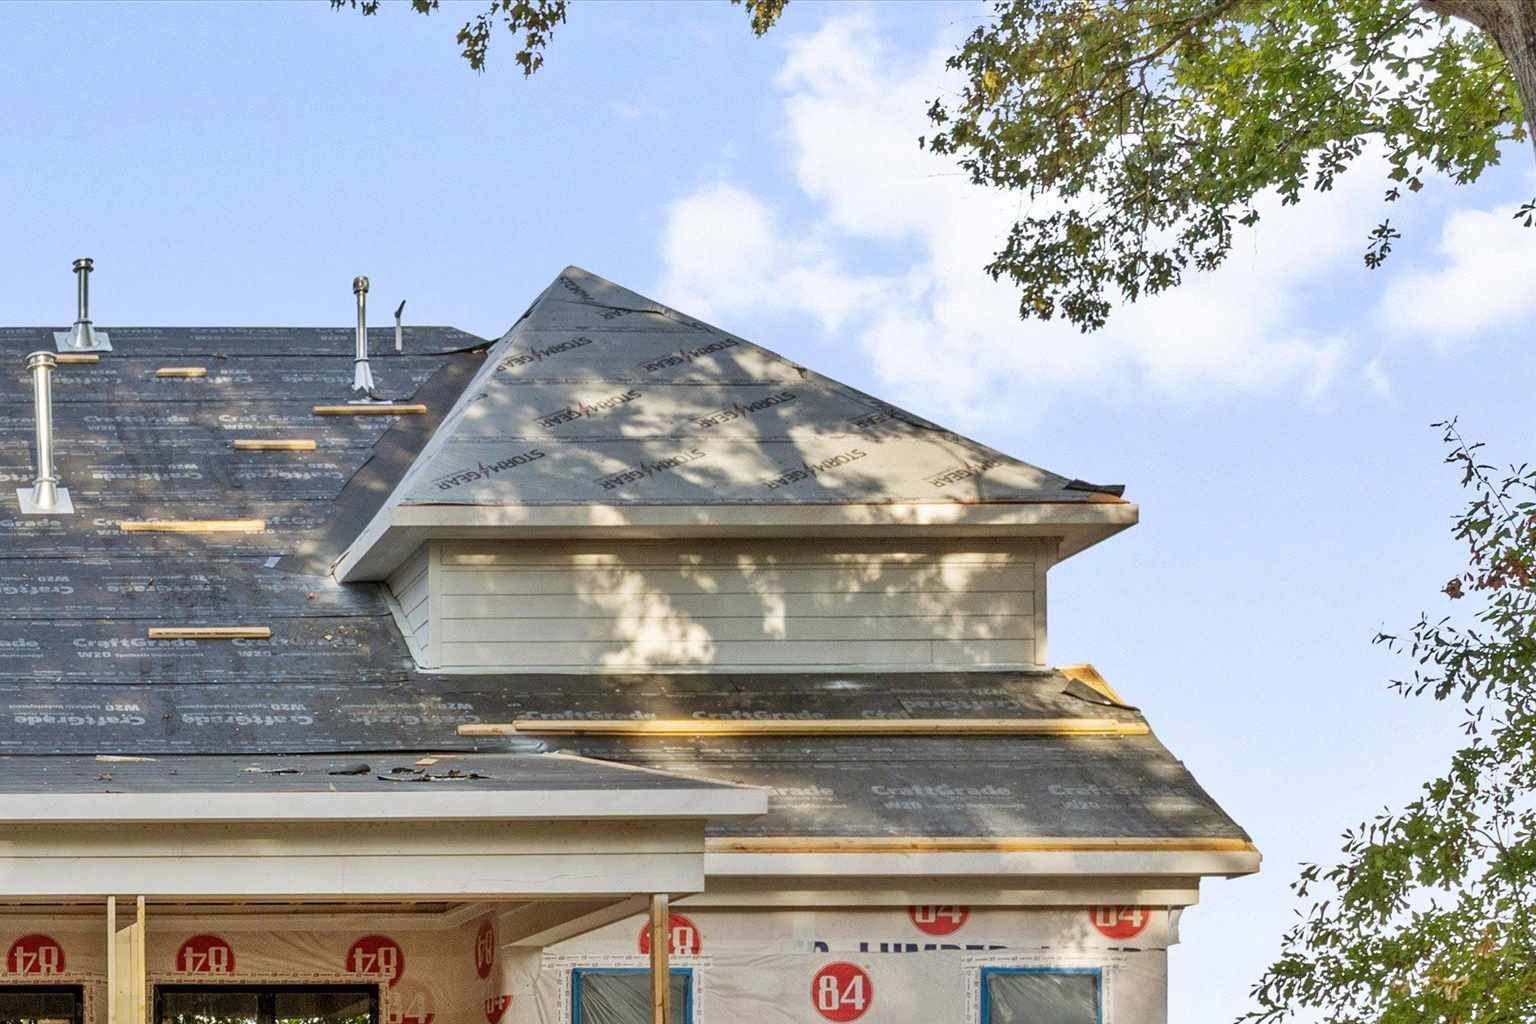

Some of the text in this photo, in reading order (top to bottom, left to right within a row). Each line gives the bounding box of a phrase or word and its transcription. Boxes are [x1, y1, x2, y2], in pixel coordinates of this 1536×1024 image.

[434, 447, 546, 491] STORM GEAR
[13, 713, 146, 726] CraftGrade
[104, 702, 141, 712] W20
[182, 713, 314, 726] CraftGrade
[270, 702, 308, 711] W20
[14, 945, 59, 975] 84
[184, 946, 228, 973] 84
[353, 946, 397, 978] 84
[817, 974, 865, 1012] 84
